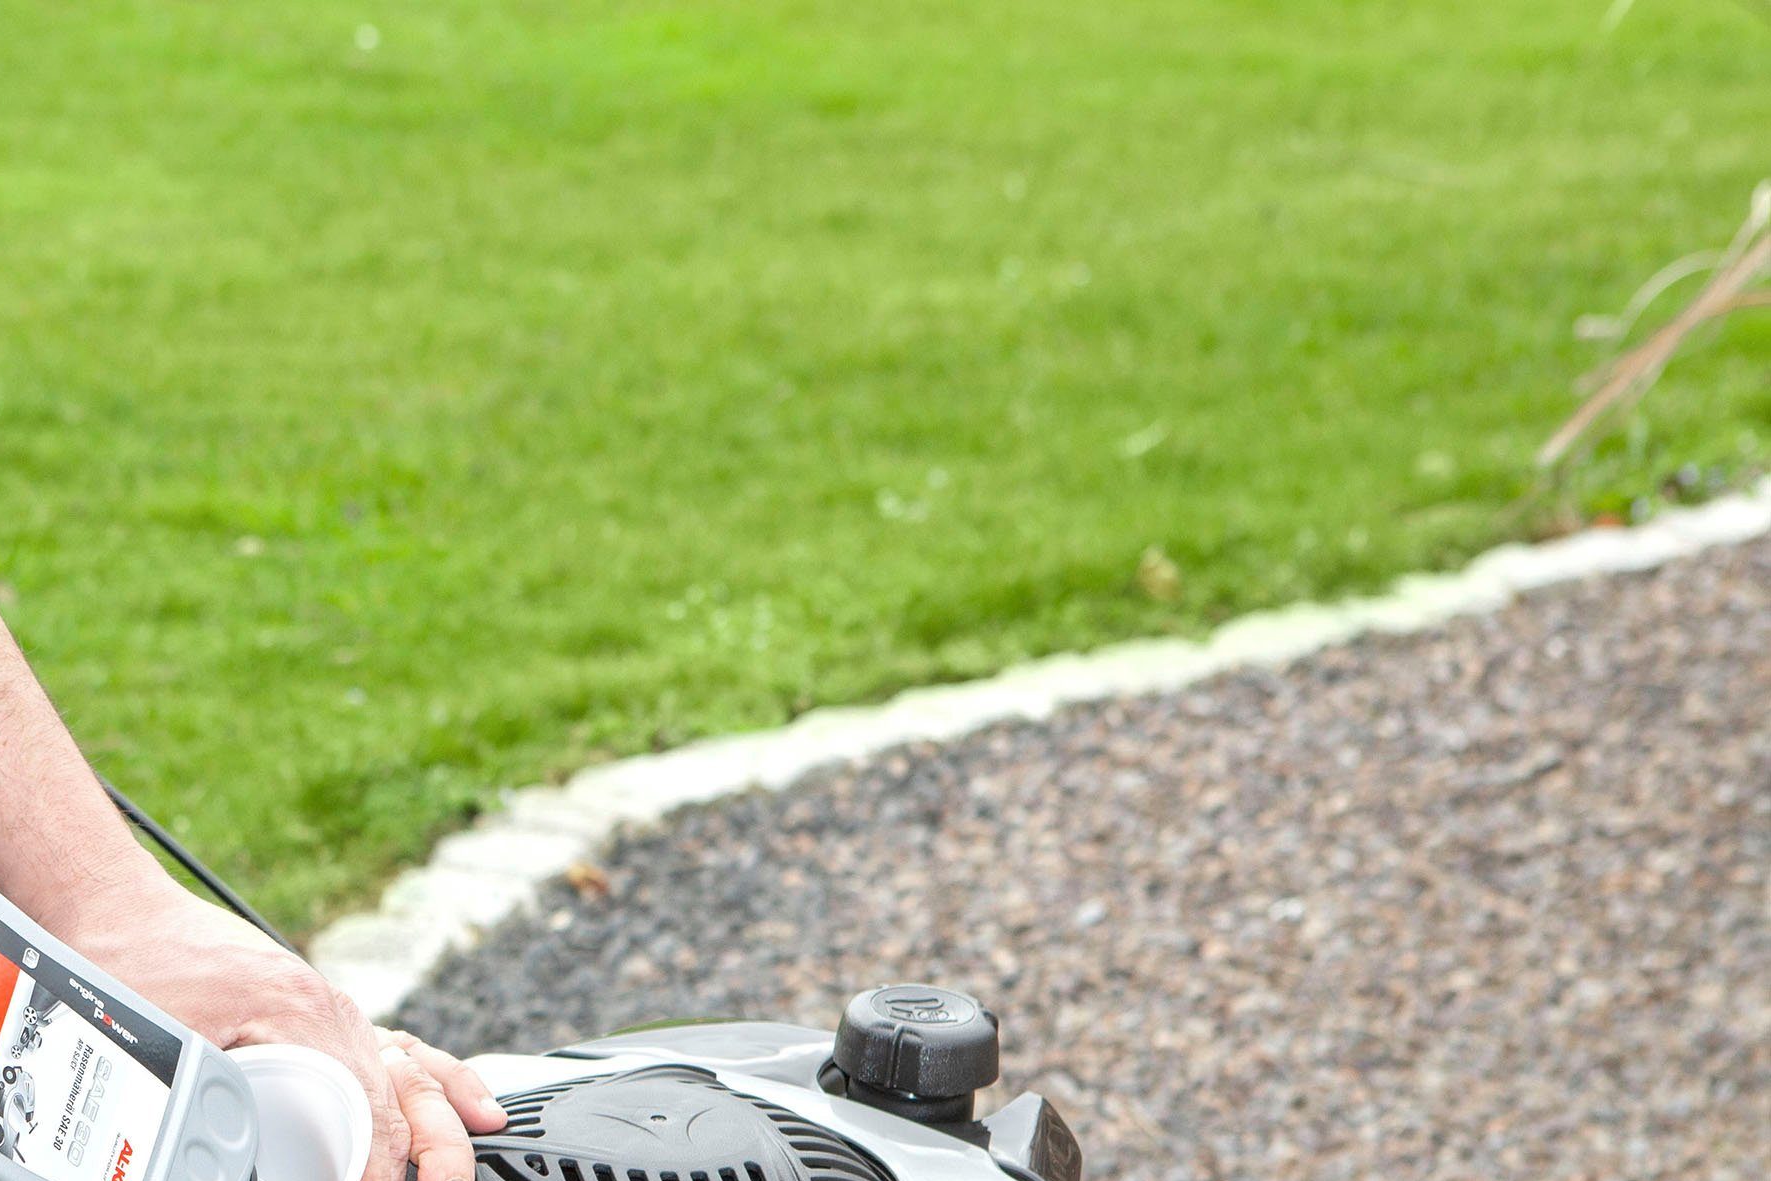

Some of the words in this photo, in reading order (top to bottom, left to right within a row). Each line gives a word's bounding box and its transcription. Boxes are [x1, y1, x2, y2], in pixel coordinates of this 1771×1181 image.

[69, 978, 105, 1010] engine
[93, 1006, 139, 1044] power
[66, 1044, 94, 1116] Rasenmäheröl
[81, 1055, 113, 1123] SAE
[53, 1135, 65, 1152] 30
[57, 1114, 72, 1137] SAE
[67, 1120, 92, 1168] 30
